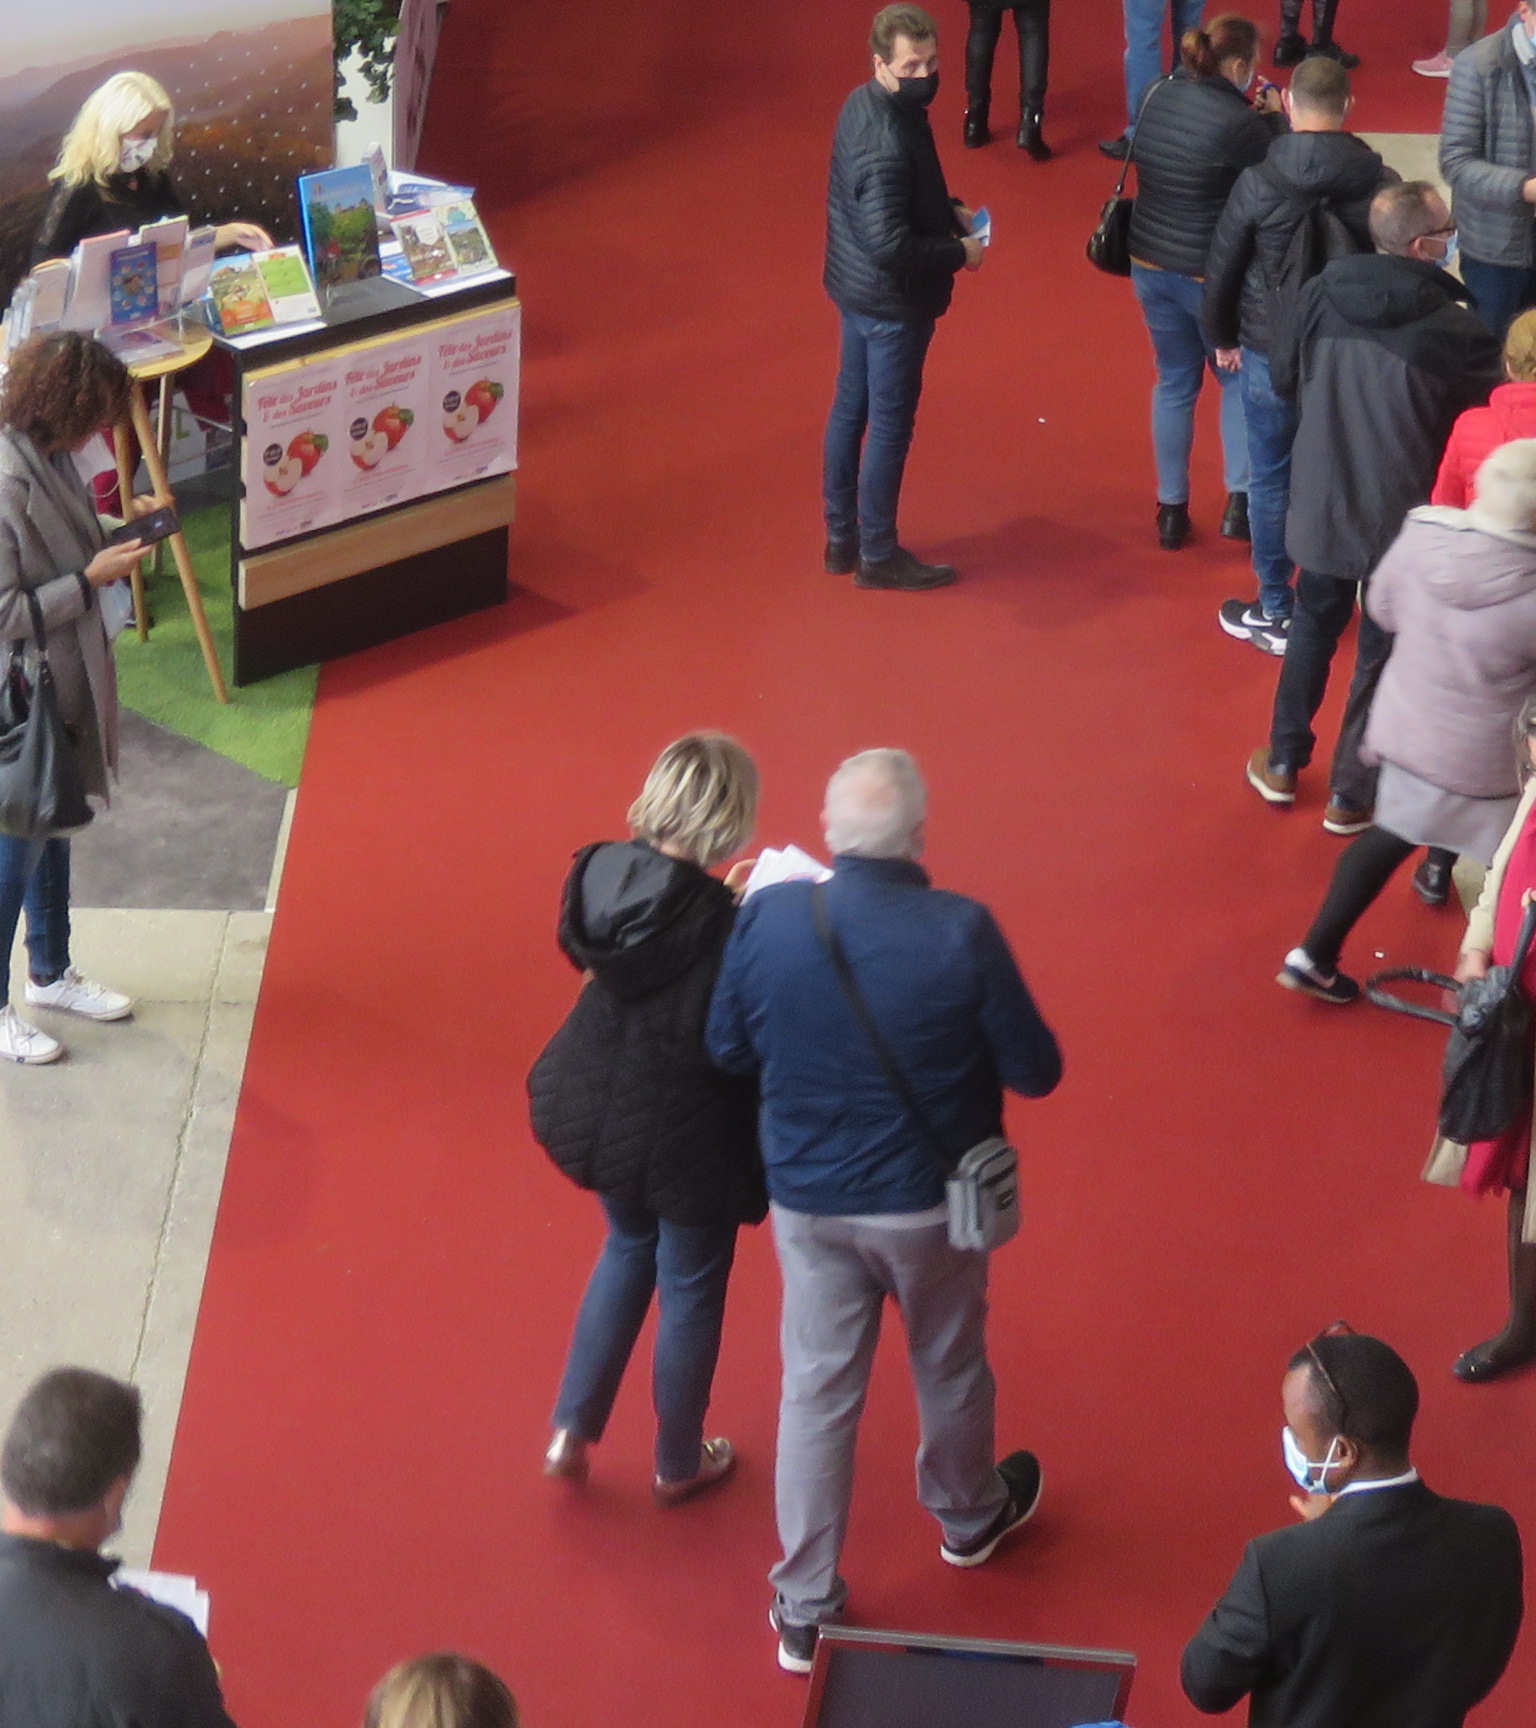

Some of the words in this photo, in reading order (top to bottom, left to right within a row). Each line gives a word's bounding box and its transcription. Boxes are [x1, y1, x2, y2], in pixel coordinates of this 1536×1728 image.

[438, 342, 457, 359] Fête
[458, 342, 472, 353] des
[475, 328, 513, 351] Jardins
[451, 356, 466, 369] des
[468, 344, 507, 365] Saveurs
[345, 369, 364, 386] Fête
[365, 367, 379, 380] des
[382, 353, 422, 376] Jardins
[359, 382, 373, 395] des
[375, 370, 416, 392] Saveurs
[258, 395, 278, 411] Fête
[279, 392, 293, 404] des
[297, 378, 337, 403] Jardins
[272, 406, 287, 419] des
[289, 394, 332, 417] Saveurs
